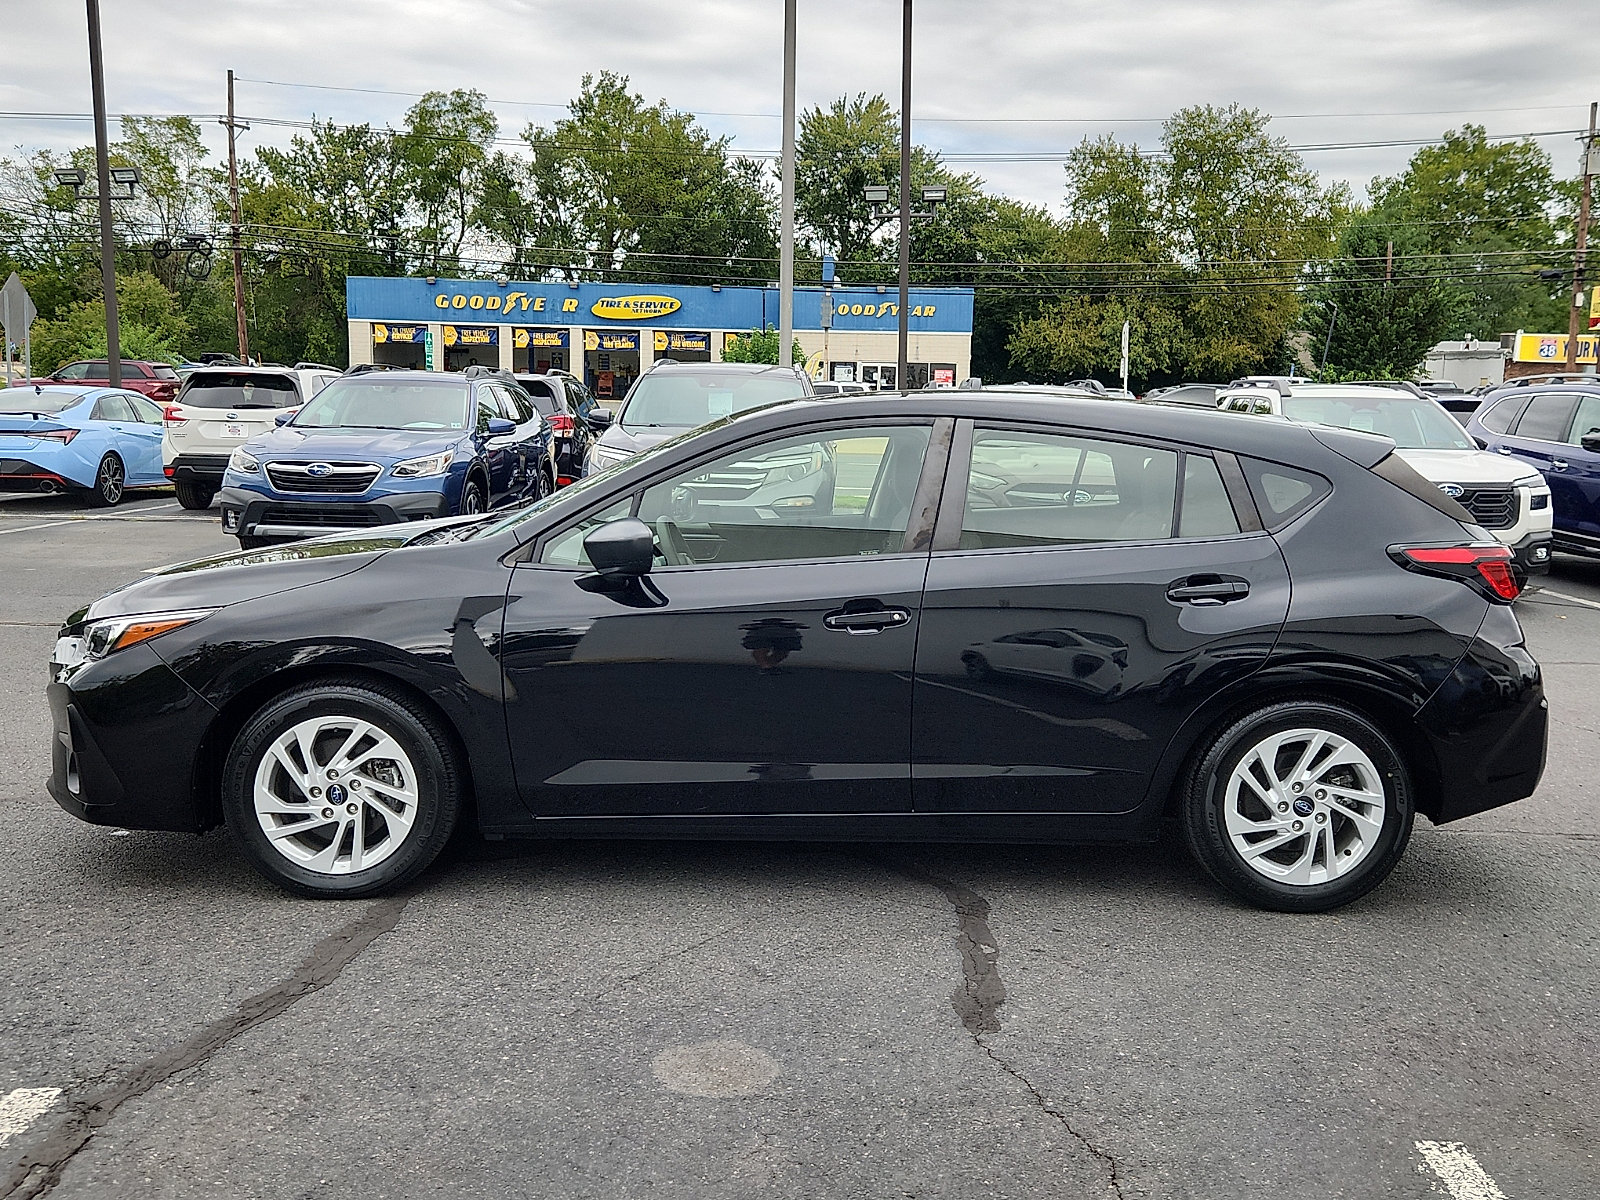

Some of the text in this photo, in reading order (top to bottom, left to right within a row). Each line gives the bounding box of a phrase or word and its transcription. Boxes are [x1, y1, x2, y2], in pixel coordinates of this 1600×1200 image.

[435, 293, 579, 313] GOODYER
[600, 300, 676, 309] TIRE & SERVICE
[832, 303, 936, 317] OODYAR
[461, 329, 472, 337] FREE
[532, 332, 543, 340] FREE
[681, 340, 706, 348] WELCOME
[1540, 345, 1556, 357] 38
[1563, 341, 1590, 358] YUR
